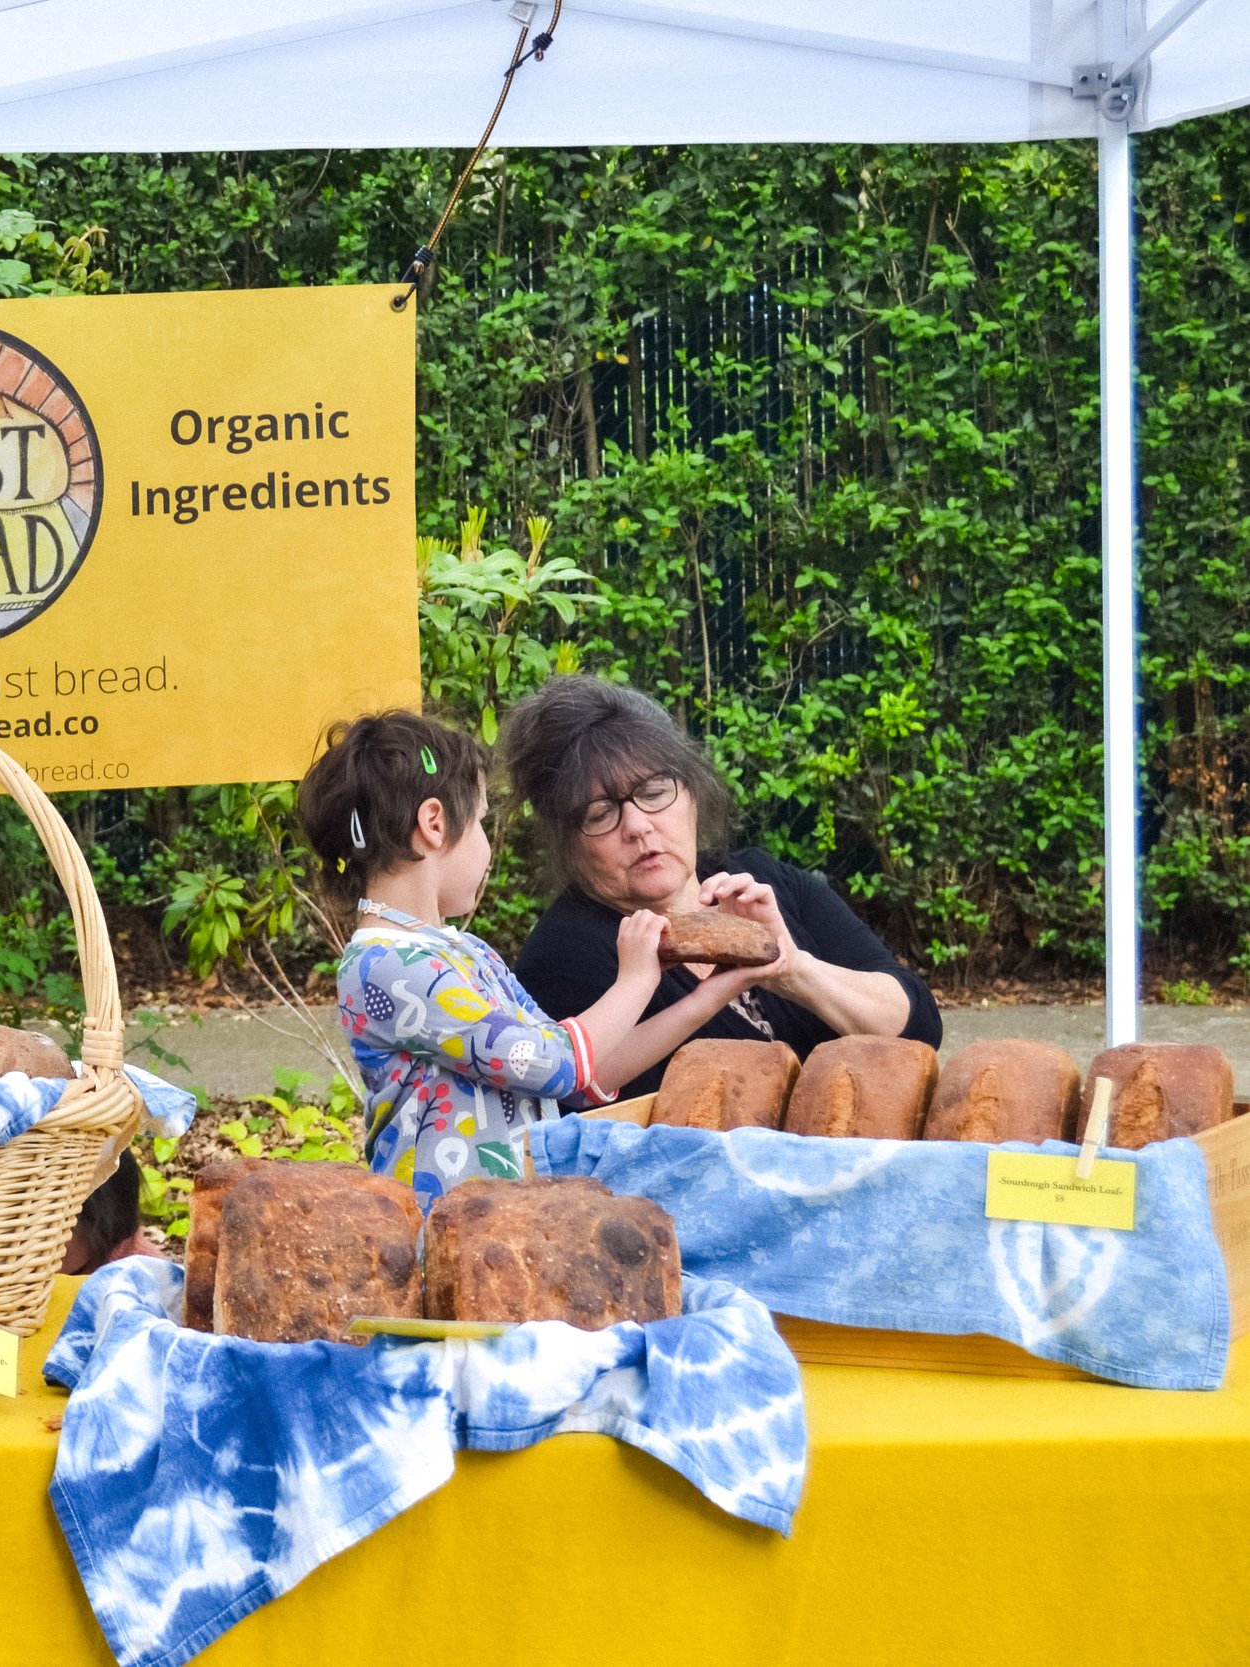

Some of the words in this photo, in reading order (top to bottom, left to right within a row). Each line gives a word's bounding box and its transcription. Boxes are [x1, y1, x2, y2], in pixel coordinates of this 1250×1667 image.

[170, 402, 350, 454] Organic
[131, 471, 391, 525] Ingredients
[53, 656, 179, 696] bread.
[998, 1176, 1050, 1190] -Sourdough
[1052, 1181, 1097, 1193] Sandwich
[1099, 1185, 1123, 1195] Loaf-
